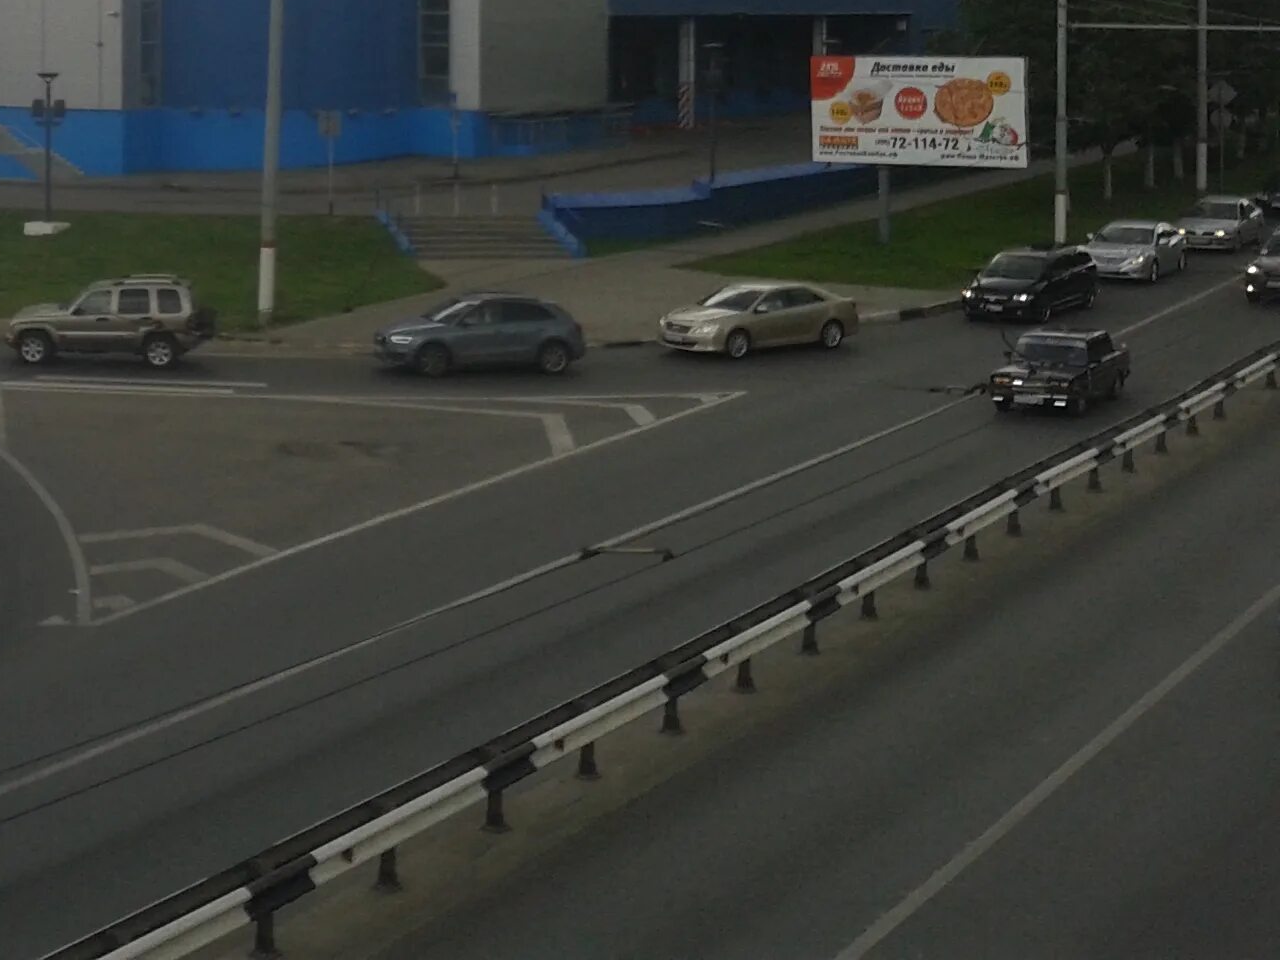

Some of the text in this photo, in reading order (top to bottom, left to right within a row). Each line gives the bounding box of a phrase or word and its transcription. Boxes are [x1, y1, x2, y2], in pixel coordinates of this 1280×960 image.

[871, 62, 955, 76] Доставка еды
[890, 137, 960, 151] 72-114-72
